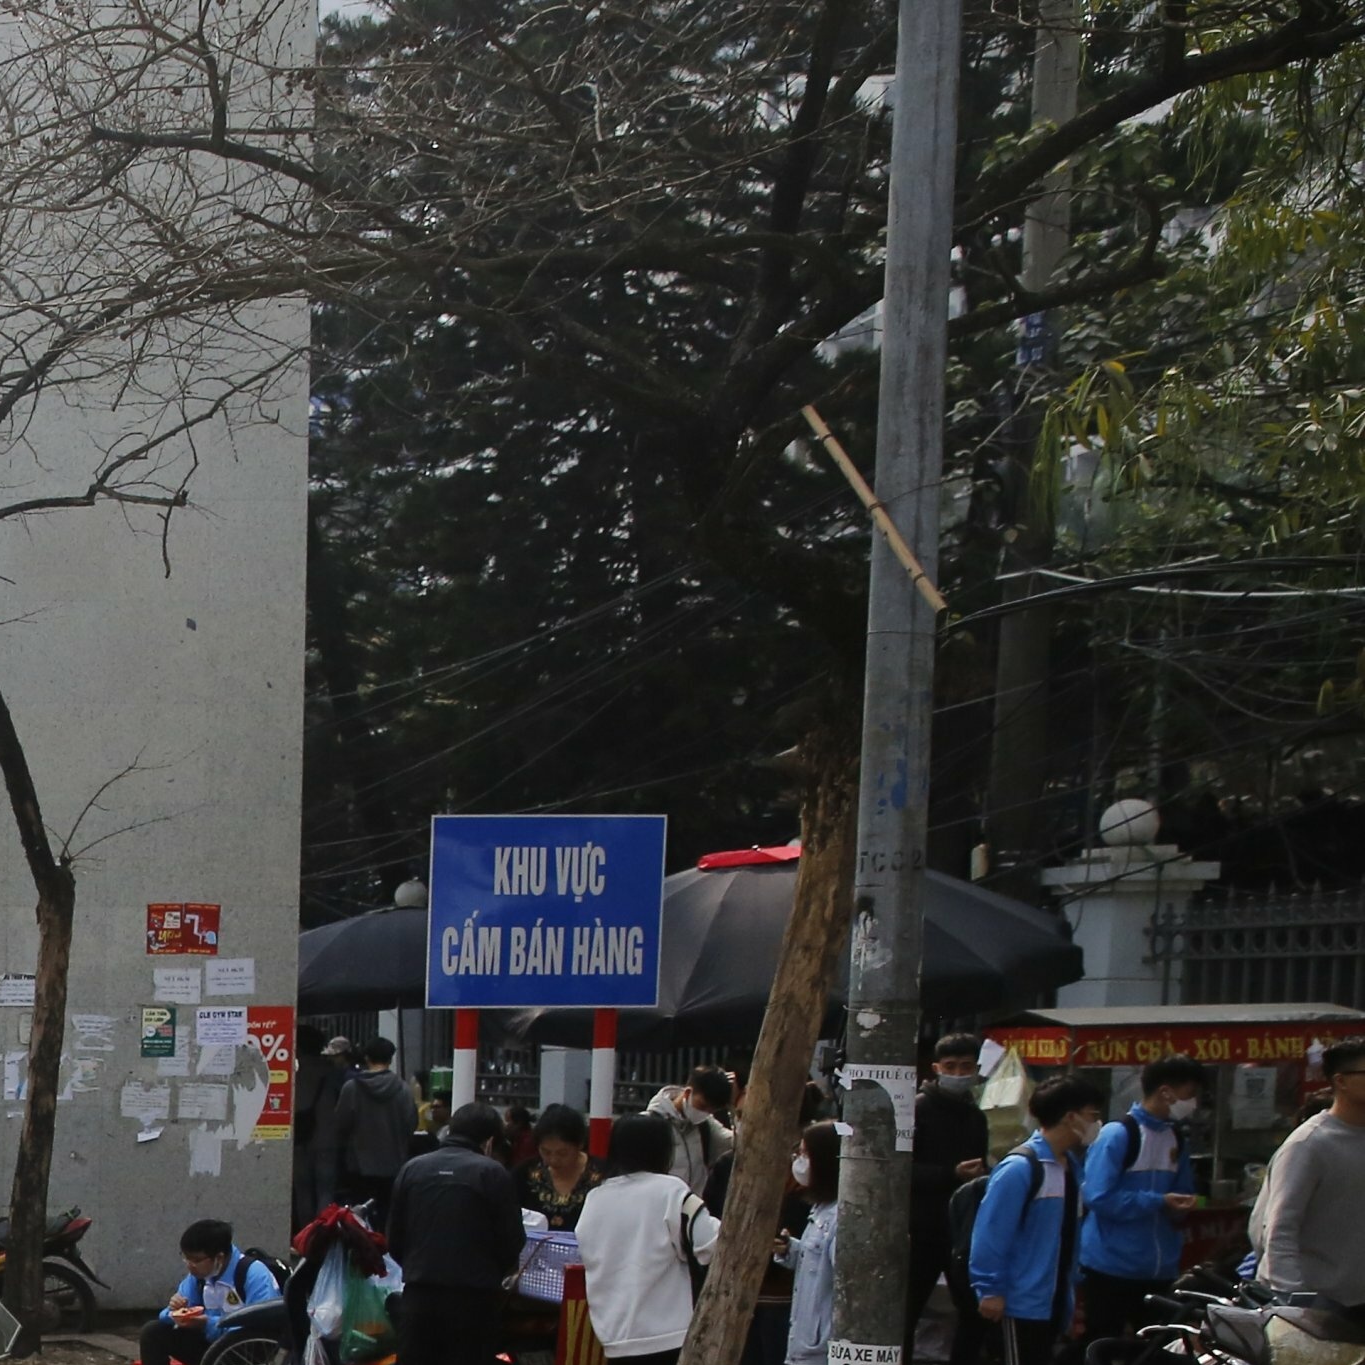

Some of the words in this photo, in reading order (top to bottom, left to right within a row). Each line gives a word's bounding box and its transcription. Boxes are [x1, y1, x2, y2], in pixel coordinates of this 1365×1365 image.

[494, 846, 547, 896] KHU
[555, 841, 606, 903] VỰC
[441, 910, 502, 976] CẤM
[509, 917, 565, 976] BÁN
[571, 917, 644, 976] HÀNG
[1194, 1033, 1230, 1060] XÔI
[1247, 1033, 1305, 1059] BÁNH
[831, 1344, 852, 1361] SỬA
[854, 1348, 873, 1362] XE
[876, 1346, 900, 1363] MÁY
